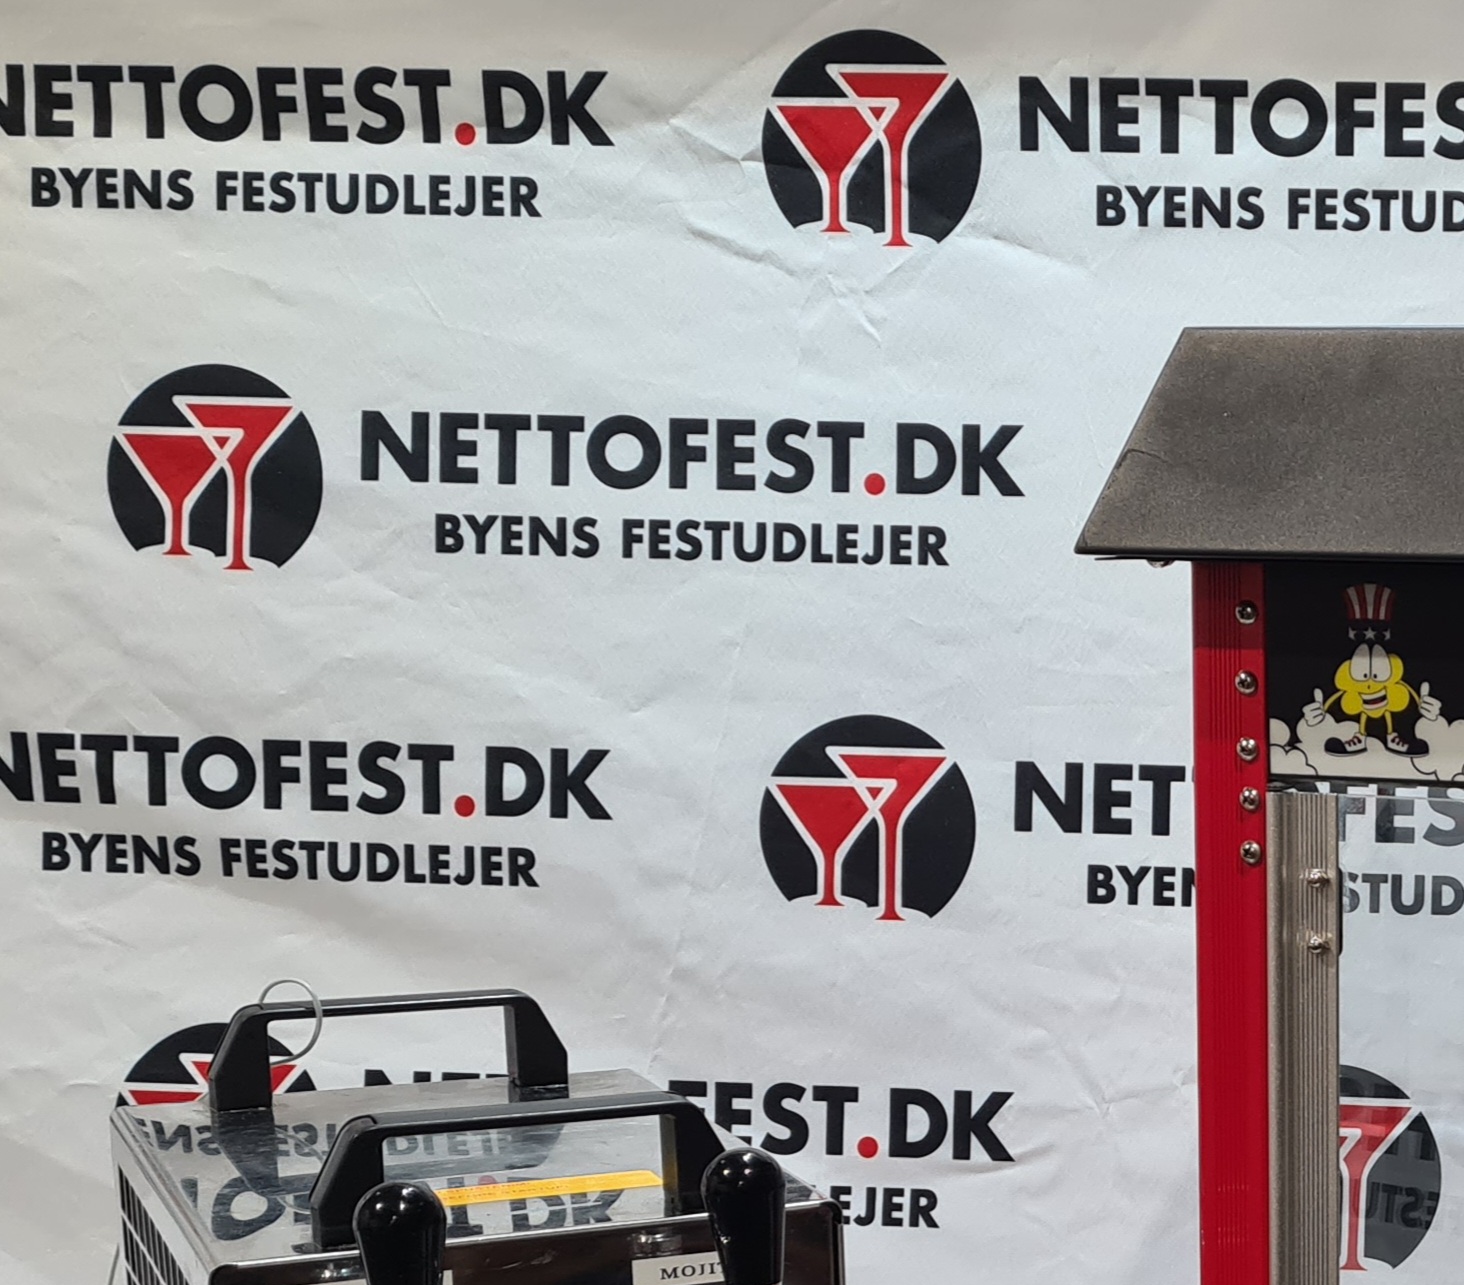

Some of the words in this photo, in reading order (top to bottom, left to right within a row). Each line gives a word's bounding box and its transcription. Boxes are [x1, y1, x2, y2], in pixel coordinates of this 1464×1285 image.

[31, 167, 194, 211] BYENS
[216, 170, 541, 218] FESTUDLEJER
[1095, 185, 1265, 230] BYENS
[360, 410, 1024, 497] NETTOFEST.DK
[434, 514, 600, 558] BYENS
[621, 518, 949, 566] FESTUDLEJER
[41, 832, 201, 876] BYENS
[220, 837, 539, 887] FESTUDLEJER
[660, 1262, 723, 1281] MOJI
